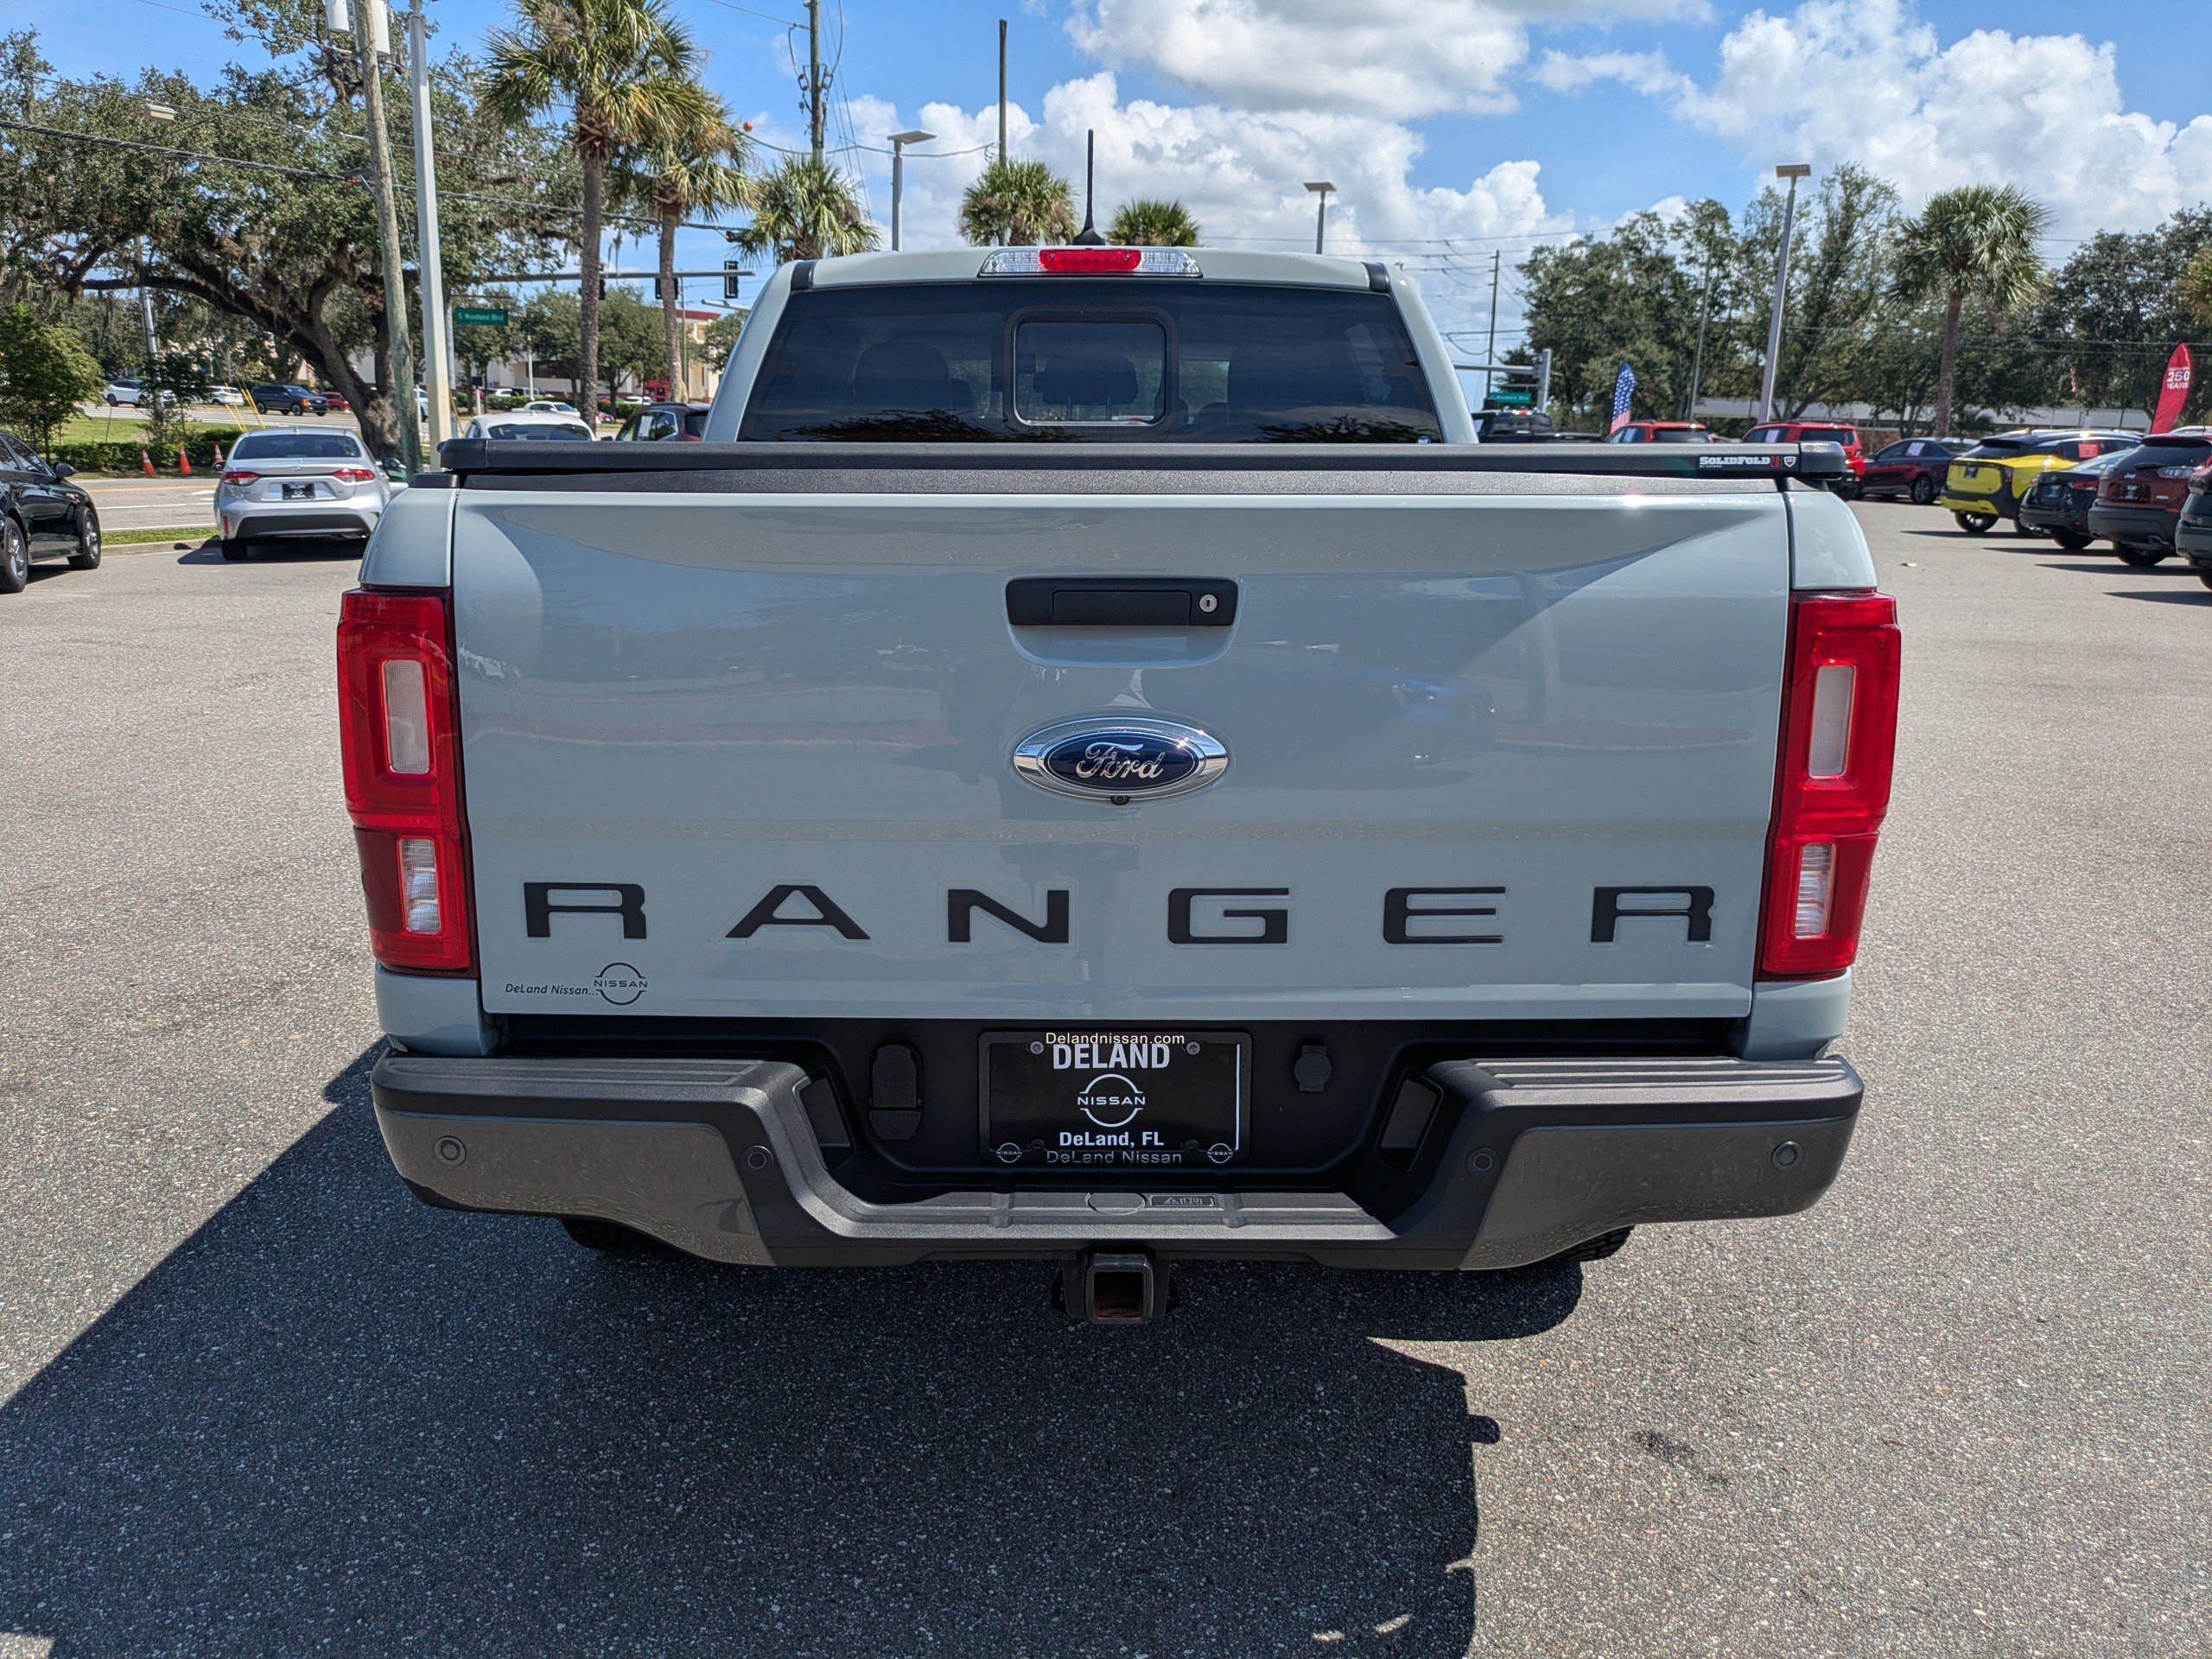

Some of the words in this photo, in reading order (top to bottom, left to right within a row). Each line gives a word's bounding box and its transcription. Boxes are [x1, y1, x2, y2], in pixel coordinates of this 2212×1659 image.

[2167, 371, 2190, 382] 250
[1699, 456, 1770, 465] SOLIDFOLD
[1075, 741, 1166, 779] Ford
[523, 881, 1715, 945] RANGER
[505, 983, 548, 994] DeLand
[594, 979, 648, 988] NISSAN
[1046, 1032, 1185, 1045] Delandnissan.com
[1052, 1044, 1170, 1070] DELAND
[1077, 1096, 1146, 1106] NISSAN
[1059, 1132, 1135, 1148] DeLand,
[1142, 1132, 1165, 1147] FL
[1046, 1150, 1115, 1164] DeLand
[1122, 1151, 1182, 1165] Nissan
